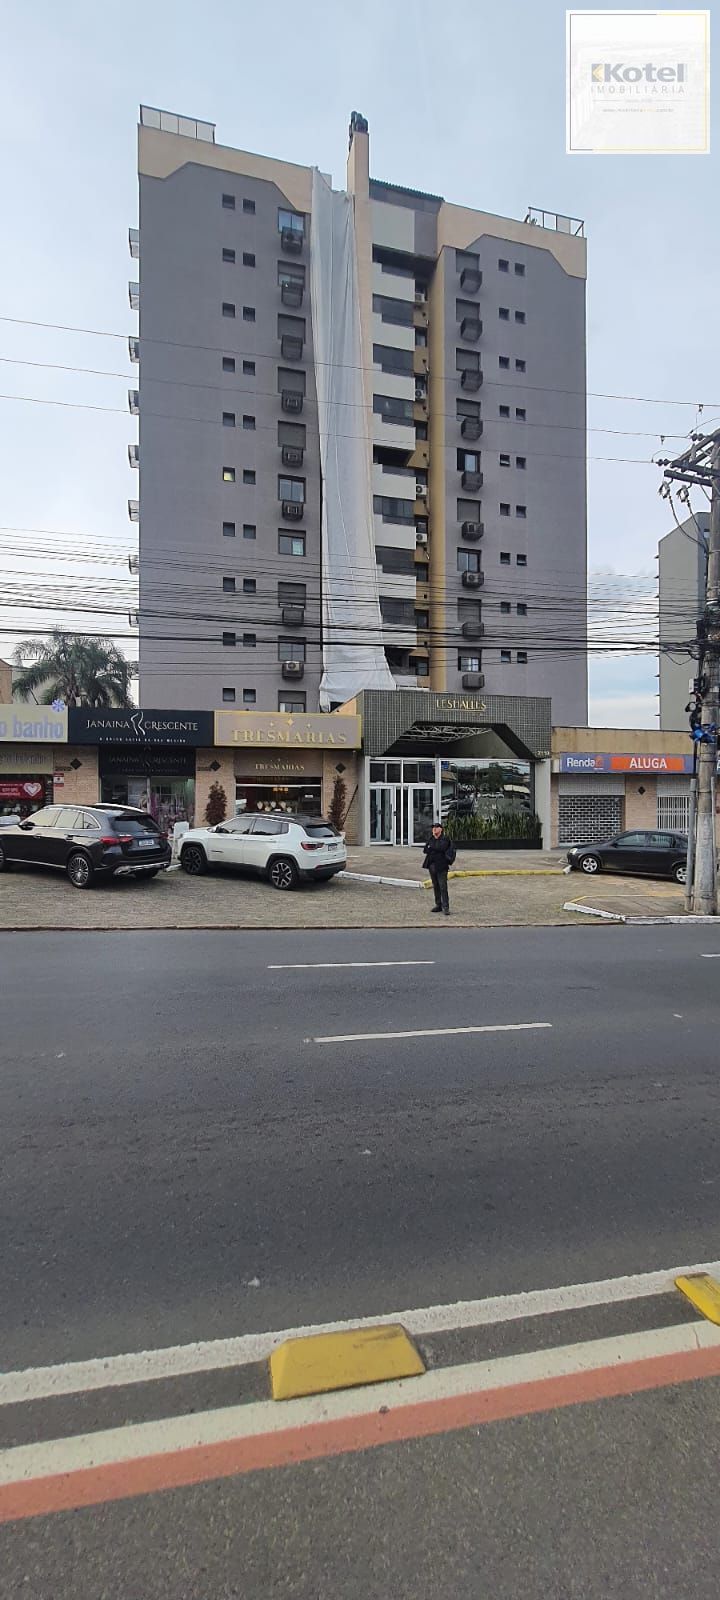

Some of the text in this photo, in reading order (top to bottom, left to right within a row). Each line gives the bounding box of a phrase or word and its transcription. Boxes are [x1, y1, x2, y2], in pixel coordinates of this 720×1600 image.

[12, 715, 64, 739] banho
[86, 720, 198, 731] JANAINA CRESCENTE
[566, 756, 596, 768] Renda
[629, 757, 668, 769] ALUGA
